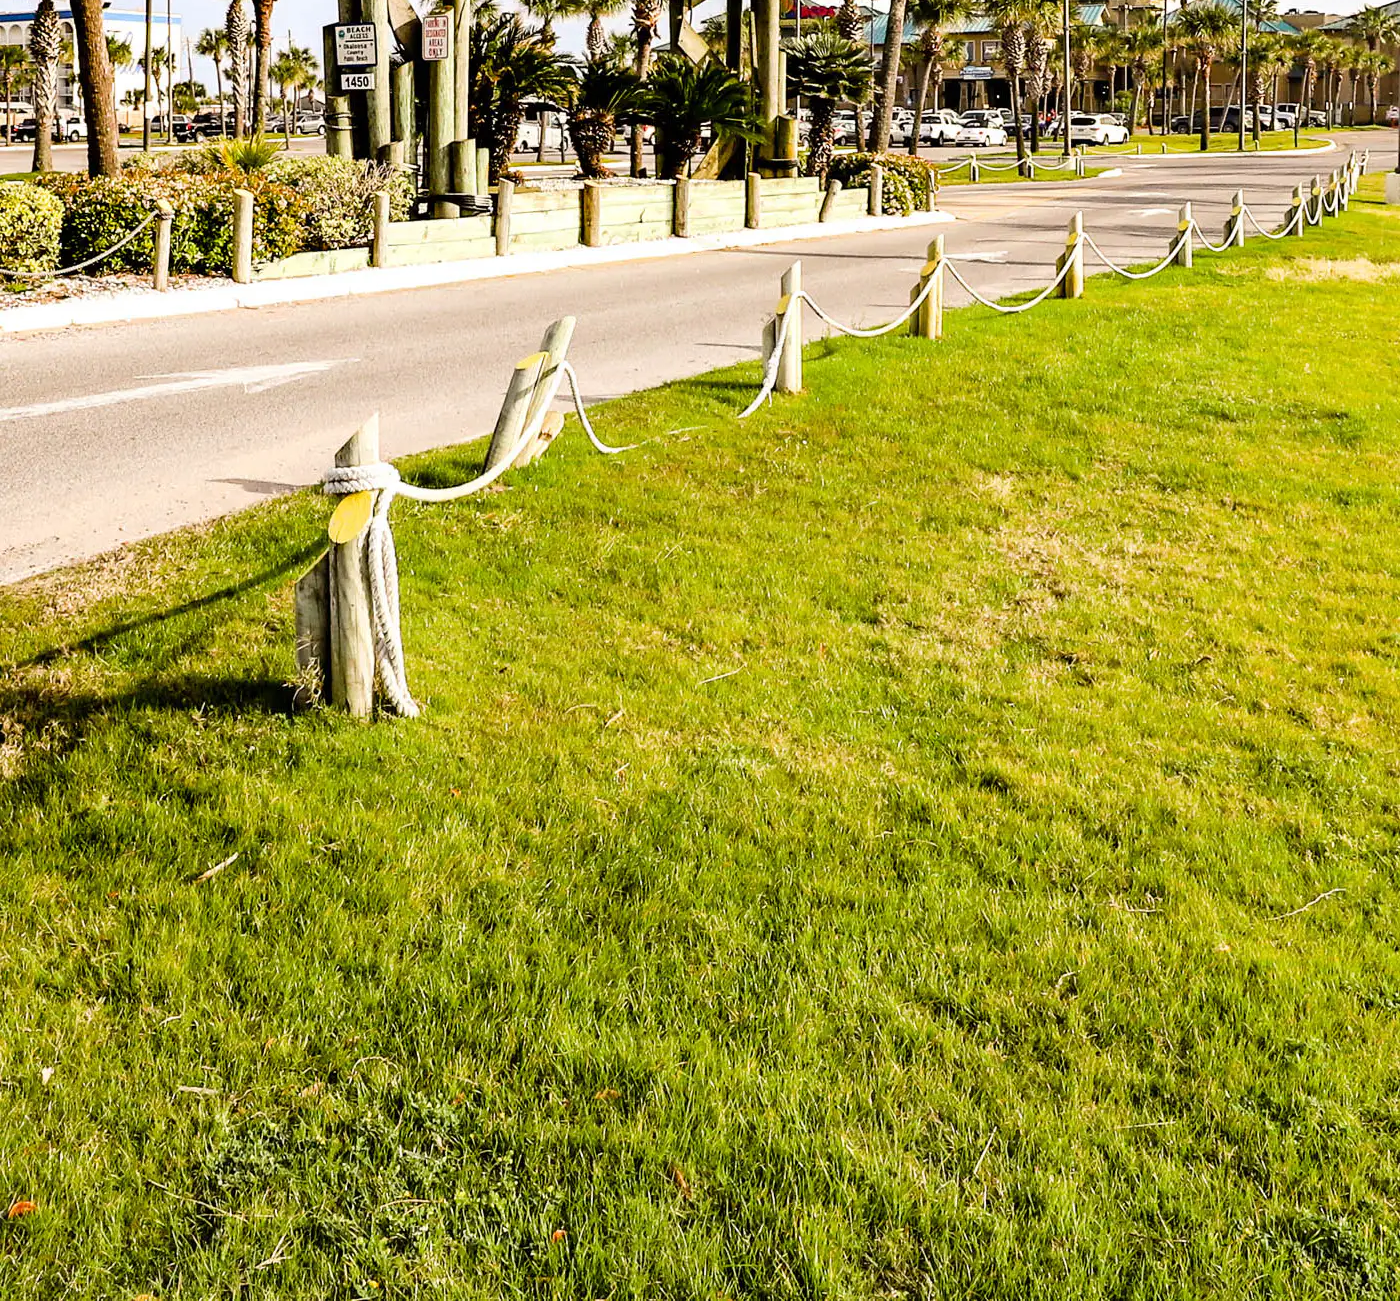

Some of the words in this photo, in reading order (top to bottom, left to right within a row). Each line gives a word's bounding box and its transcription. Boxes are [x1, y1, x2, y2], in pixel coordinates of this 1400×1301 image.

[346, 26, 371, 34] BEACH
[429, 38, 443, 47] AREAS
[428, 48, 443, 57] ONLY
[345, 76, 369, 88] 1450
